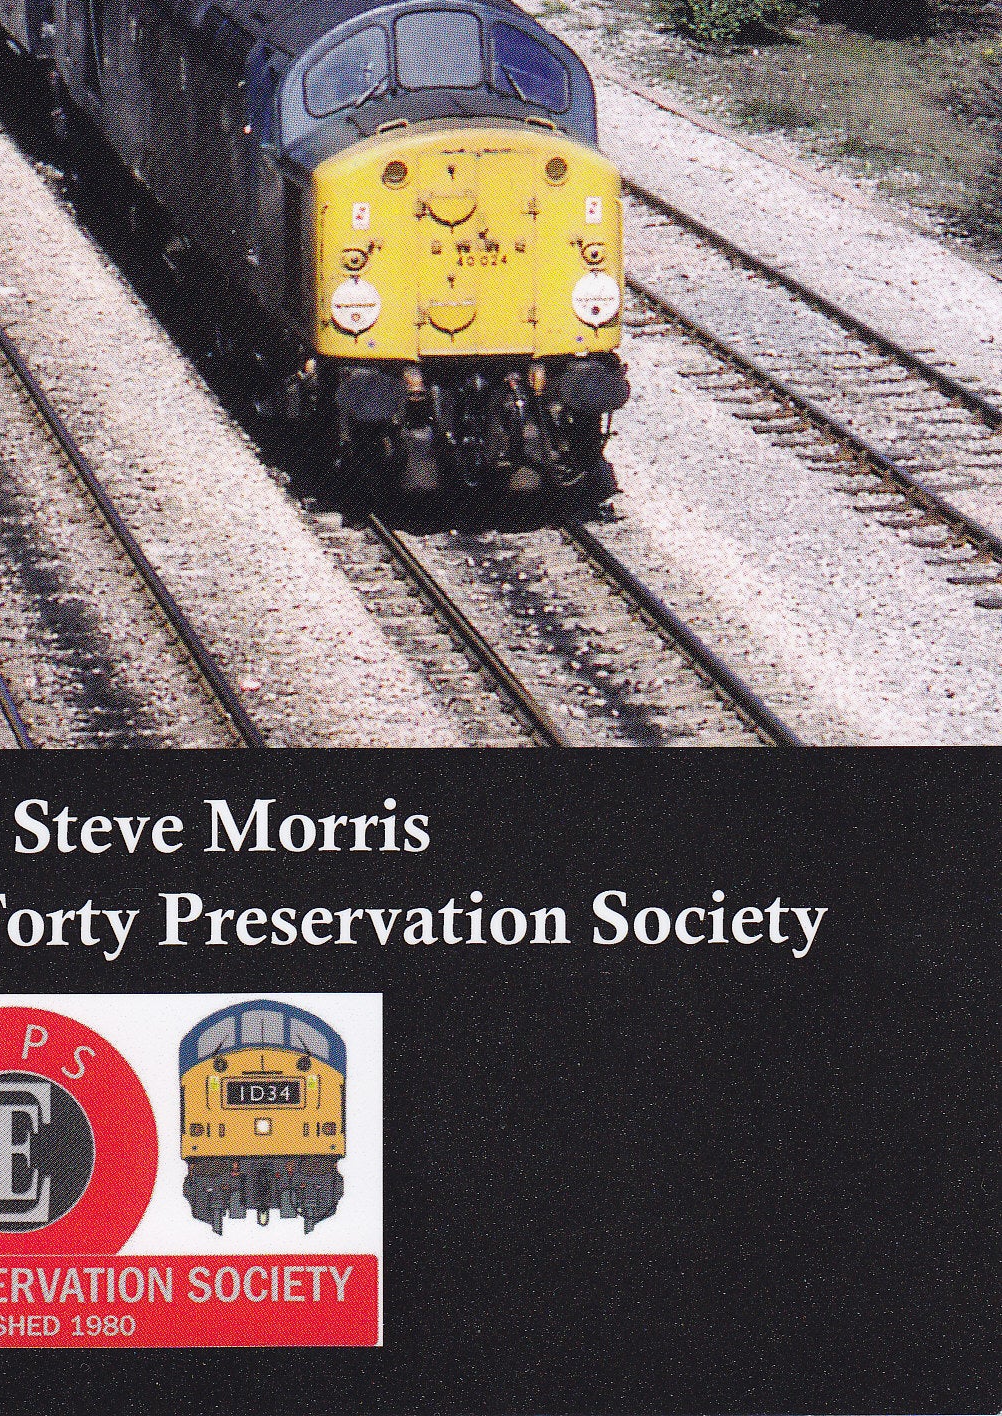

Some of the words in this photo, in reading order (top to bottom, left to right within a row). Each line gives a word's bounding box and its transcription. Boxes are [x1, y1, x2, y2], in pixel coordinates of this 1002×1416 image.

[16, 800, 184, 854] Steve
[206, 799, 431, 853] Morris
[160, 892, 571, 946] Preservation
[594, 891, 828, 959] Society
[188, 1266, 354, 1304] SOCIETY
[73, 1316, 136, 1337] 1980
